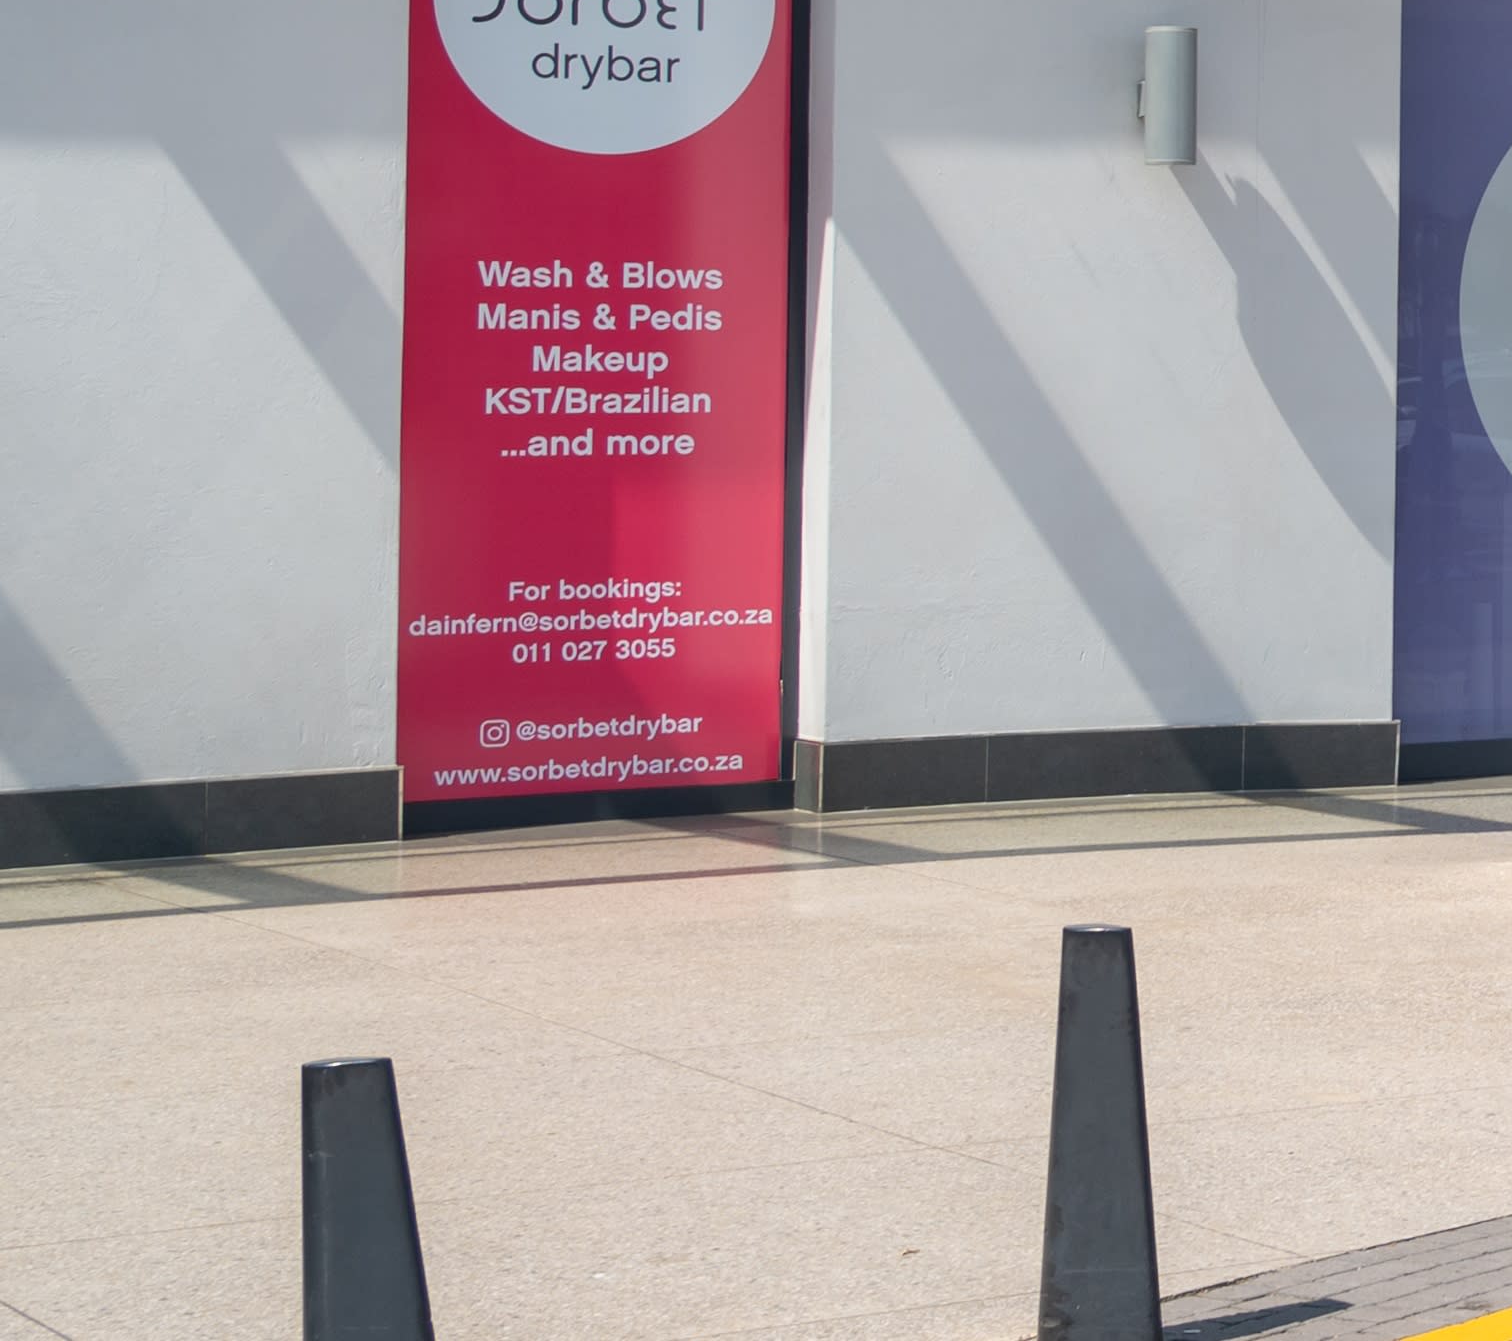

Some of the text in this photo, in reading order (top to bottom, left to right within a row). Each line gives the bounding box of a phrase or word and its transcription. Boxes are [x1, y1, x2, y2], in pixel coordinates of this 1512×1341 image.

[531, 42, 681, 90] drybar
[478, 259, 723, 291] Wash & Blows
[477, 303, 723, 332] Manis & Pedis
[531, 343, 669, 378] Makeup
[484, 385, 712, 416] KST/Brazilian
[606, 432, 695, 456] more
[508, 577, 682, 605] For bookings:
[408, 605, 773, 638] dainfern@sorbetdrybar.co.za
[511, 637, 676, 664] 011 027 3055
[515, 713, 703, 742] @sorbetdrybar
[433, 751, 744, 787] www.sorbetdrybar.co.za
